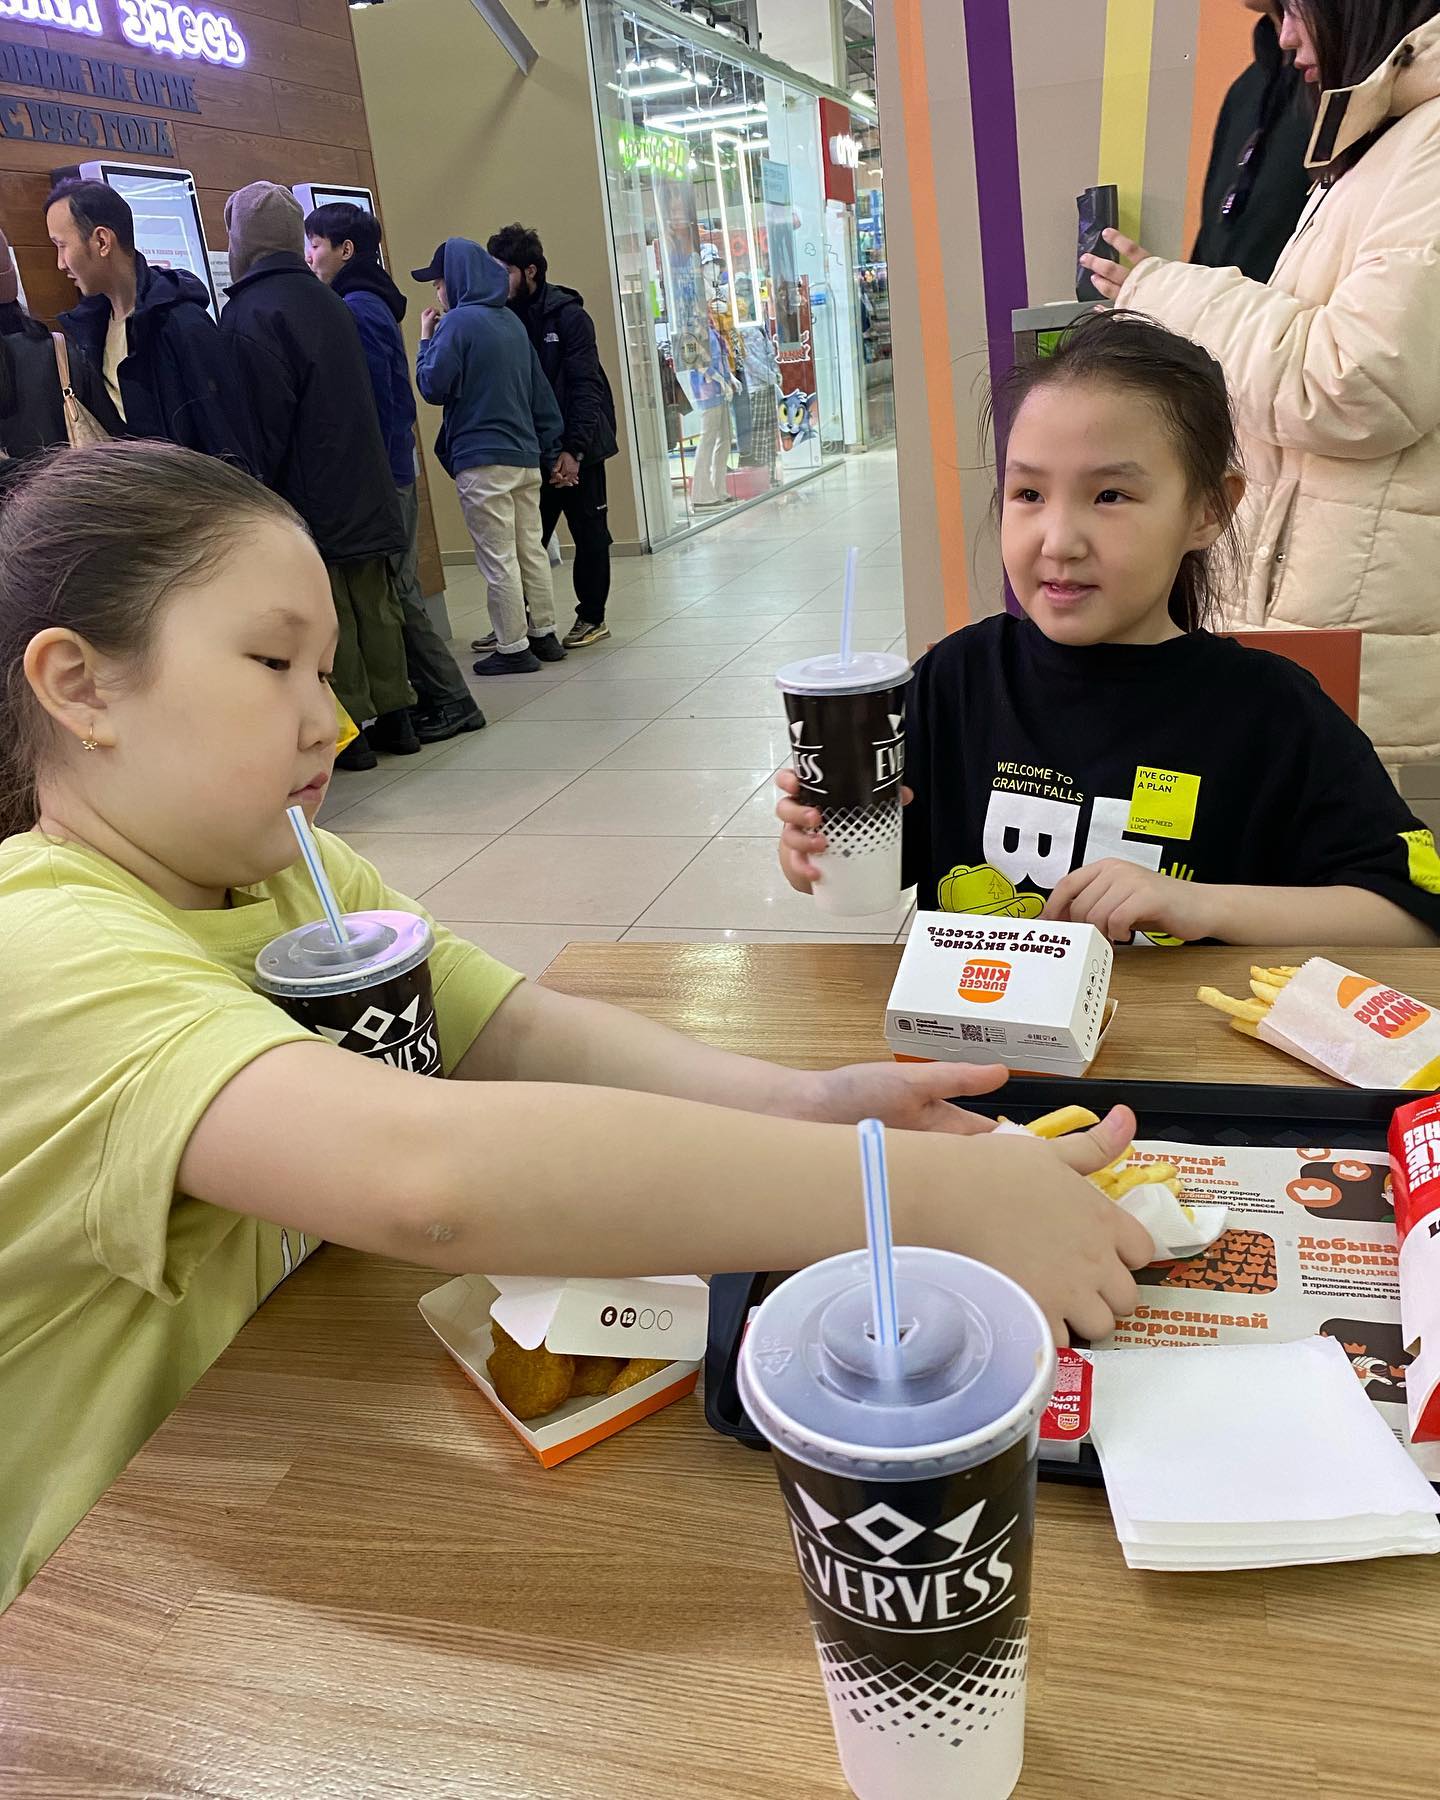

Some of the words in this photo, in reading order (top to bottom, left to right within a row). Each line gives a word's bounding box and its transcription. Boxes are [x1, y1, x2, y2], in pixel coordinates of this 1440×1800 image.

[997, 761, 1053, 780] WELCOME
[1055, 771, 1074, 785] TO
[1139, 770, 1157, 780] I'VE
[1160, 773, 1179, 783] GOT
[992, 777, 1042, 794] GRAVITY
[1043, 785, 1084, 802] FALLS
[1138, 781, 1144, 789] A
[1147, 782, 1172, 793] PLAN
[927, 926, 985, 939] съесть
[988, 930, 1020, 940] нас
[1023, 930, 1036, 941] у
[1038, 933, 1072, 946] что
[930, 935, 1007, 951] вкусное,
[1009, 943, 1066, 959] Самое
[961, 965, 1011, 981] KING
[959, 978, 1008, 992] BURGER
[1368, 998, 1426, 1039] KING
[1194, 1178, 1240, 1186] заказа
[1302, 1289, 1387, 1299] дополнительные
[1120, 1305, 1269, 1329] бменивай
[1115, 1320, 1218, 1338] короны
[1114, 1335, 1132, 1343] на
[790, 1517, 1013, 1623] EVERVESS
